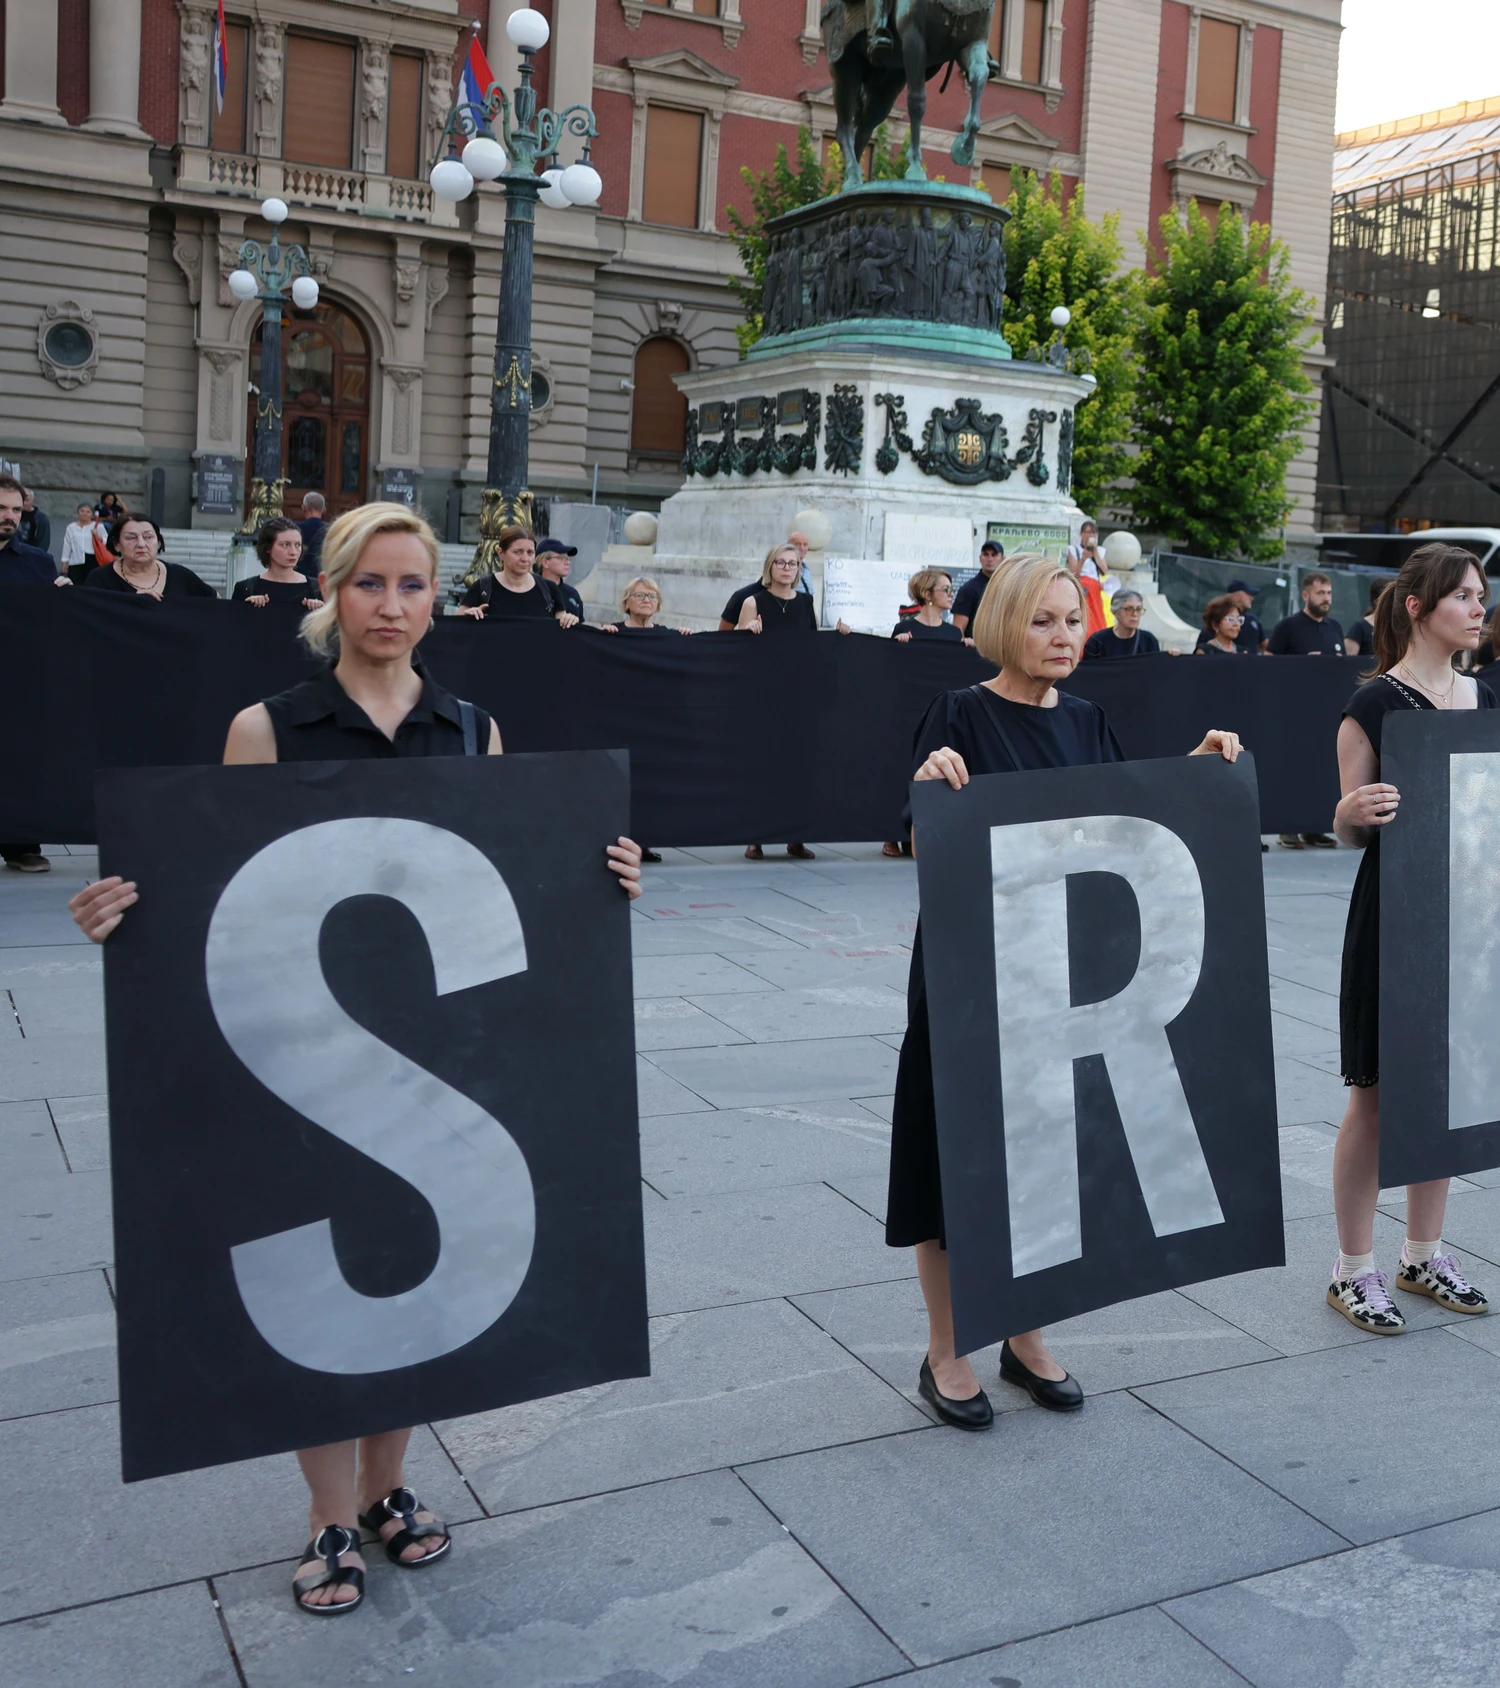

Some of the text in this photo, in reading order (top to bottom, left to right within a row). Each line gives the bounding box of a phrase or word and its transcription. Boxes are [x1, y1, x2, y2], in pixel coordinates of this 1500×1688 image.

[992, 527, 1067, 538] КРАЉЕВО 6000
[206, 817, 535, 1374] S
[990, 815, 1225, 1278] R
